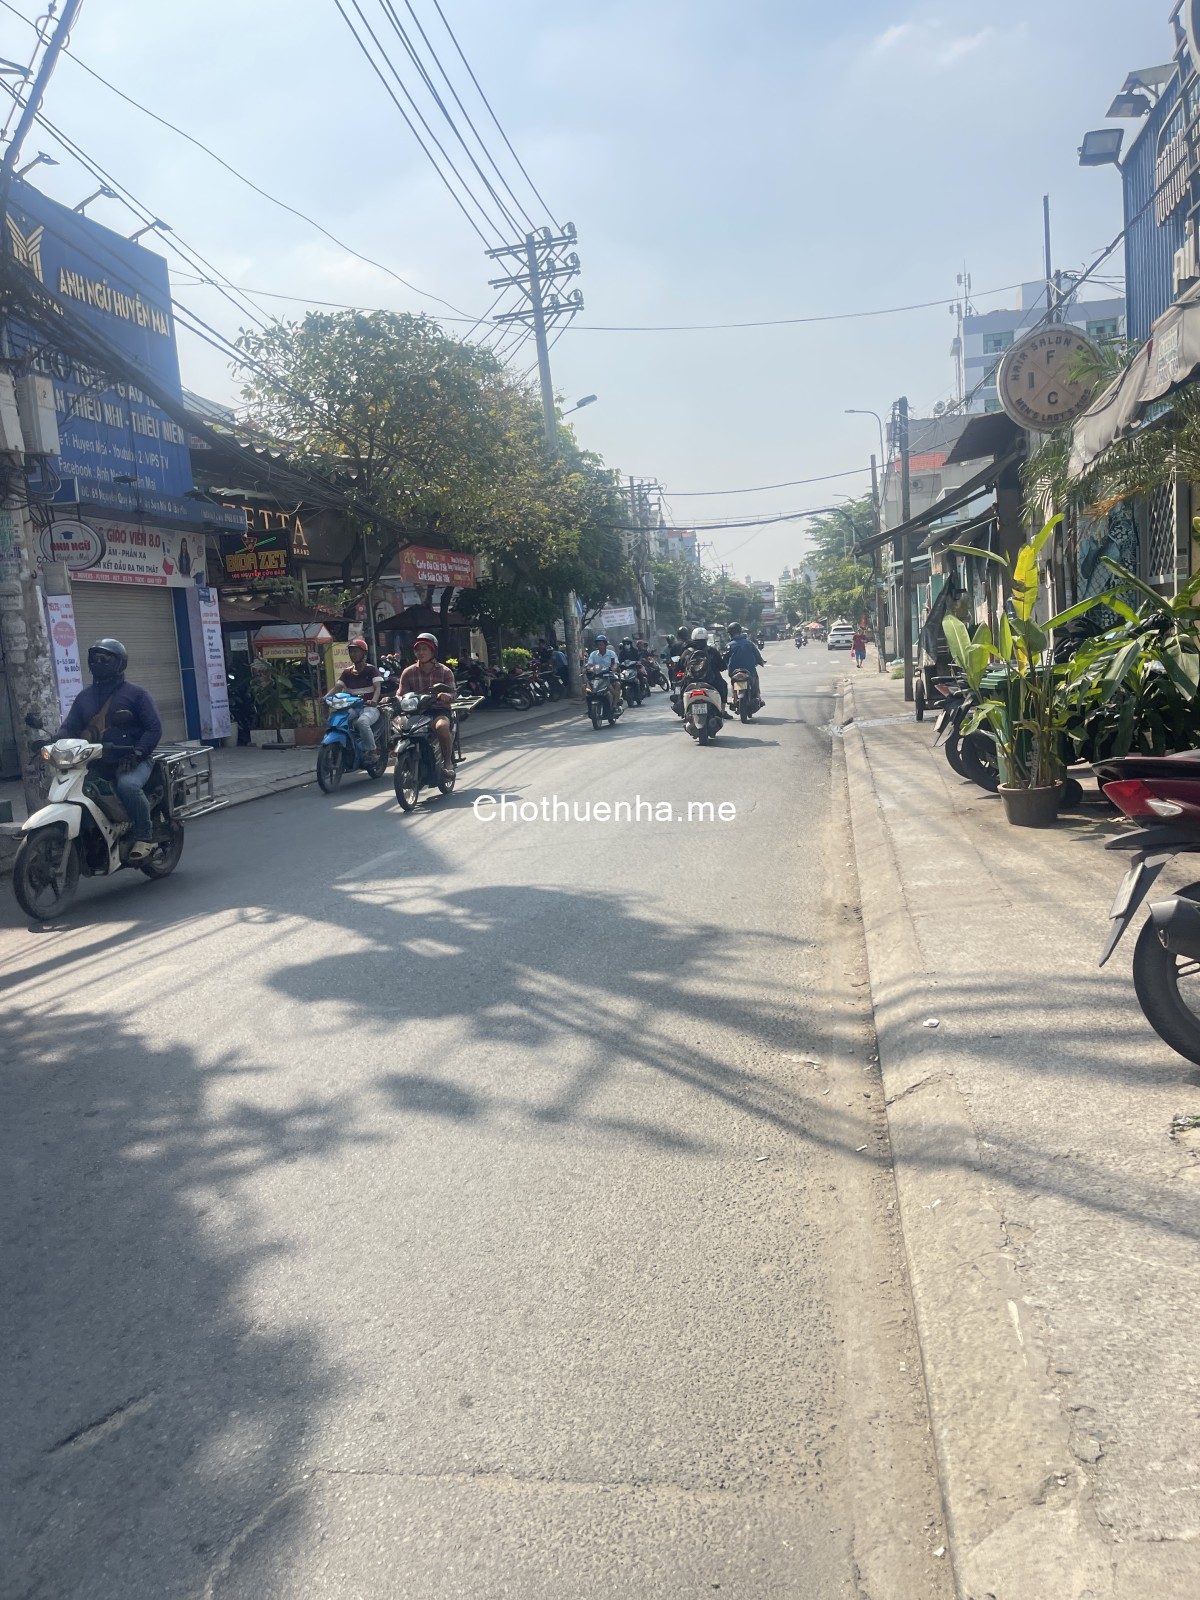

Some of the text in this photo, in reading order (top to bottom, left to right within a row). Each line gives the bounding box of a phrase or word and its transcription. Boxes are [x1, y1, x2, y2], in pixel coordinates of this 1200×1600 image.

[60, 267, 86, 302] ANH
[151, 308, 170, 337] MAI
[1031, 336, 1072, 351] SALON
[103, 403, 123, 429] NHI
[223, 503, 307, 546] ETTA
[106, 526, 127, 544] GIÁO
[129, 529, 147, 547] VIÊN
[148, 534, 161, 548] 8.0
[226, 549, 287, 573] BIDA ZET
[293, 547, 310, 556] BRAND
[128, 563, 135, 572] RA
[136, 564, 145, 572] THI
